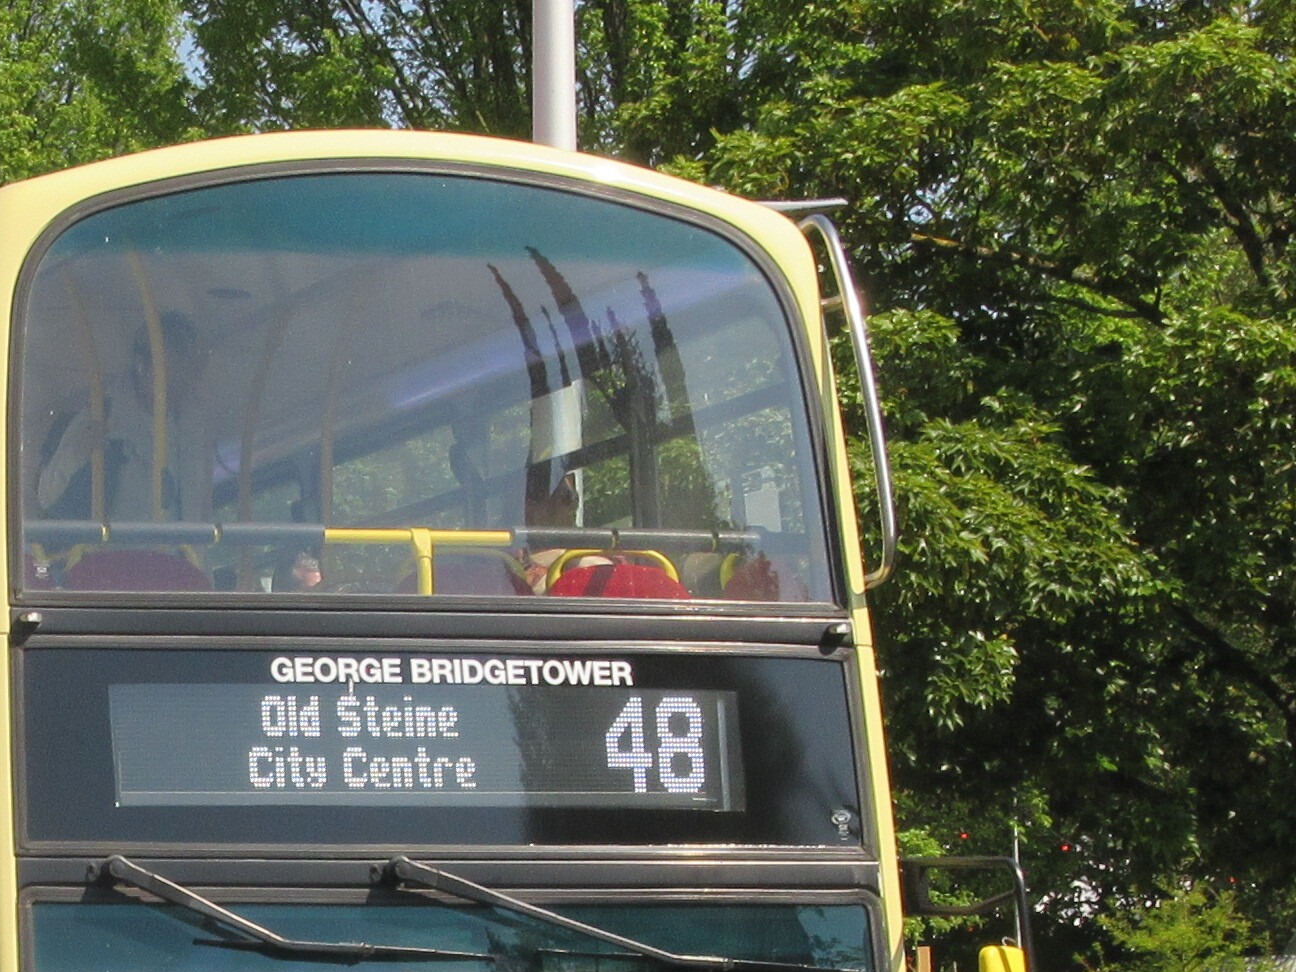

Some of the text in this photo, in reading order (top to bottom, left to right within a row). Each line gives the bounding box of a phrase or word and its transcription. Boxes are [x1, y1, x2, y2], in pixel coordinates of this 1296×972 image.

[270, 657, 634, 687] GEORGE BRIDGETOWER
[260, 694, 460, 738] Old Steine
[605, 696, 706, 794] 48
[248, 746, 478, 789] City Centre
